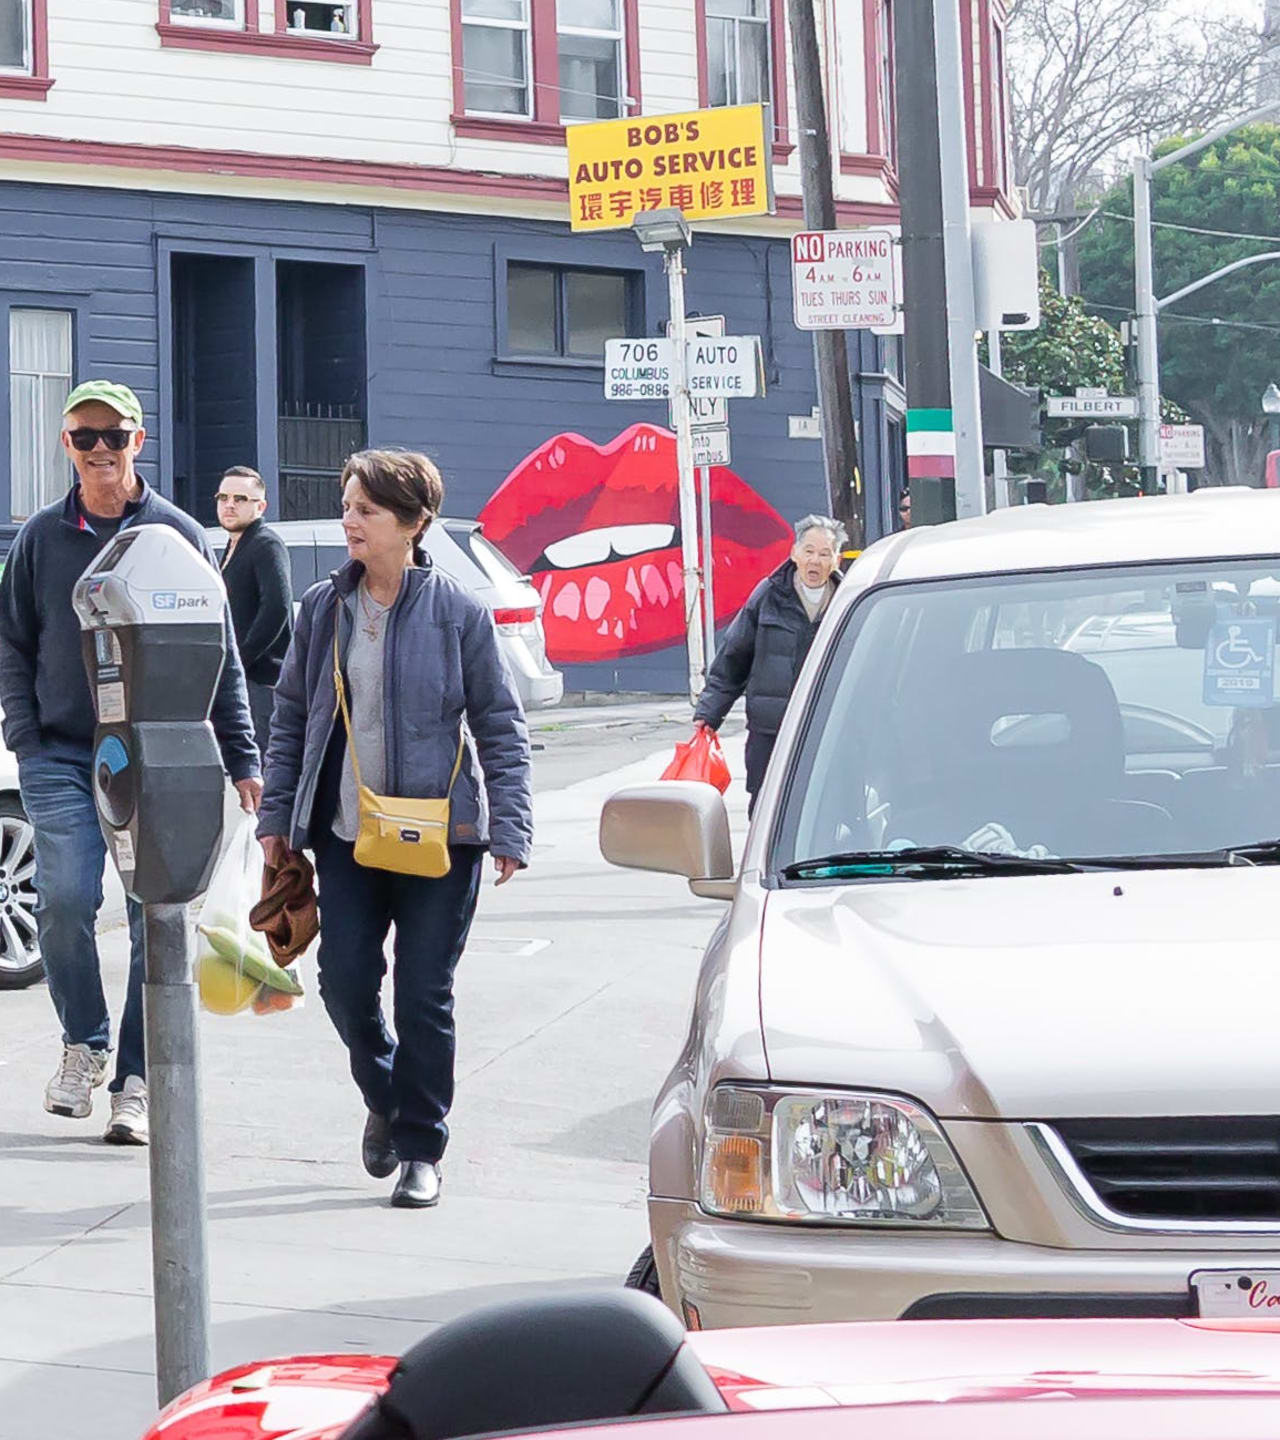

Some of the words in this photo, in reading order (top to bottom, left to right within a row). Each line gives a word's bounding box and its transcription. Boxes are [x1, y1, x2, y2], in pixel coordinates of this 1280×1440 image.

[627, 120, 700, 147] BOB'S
[575, 158, 643, 184] AUTO
[653, 146, 757, 176] SERVICE
[795, 235, 822, 261] NO
[828, 240, 887, 258] PARKING
[805, 266, 816, 283] 4
[852, 265, 863, 283] 6
[801, 292, 825, 307] TUES
[831, 291, 861, 306] THURS
[868, 290, 888, 305] SUN
[808, 314, 838, 324] STREET
[842, 313, 885, 324] CLEANING
[620, 344, 658, 362] 706
[696, 346, 738, 364] AUTO
[611, 367, 669, 380] COLUMBUS
[692, 376, 742, 390] SERVICE
[688, 397, 717, 417] NLY
[1061, 401, 1123, 411] FILBERT
